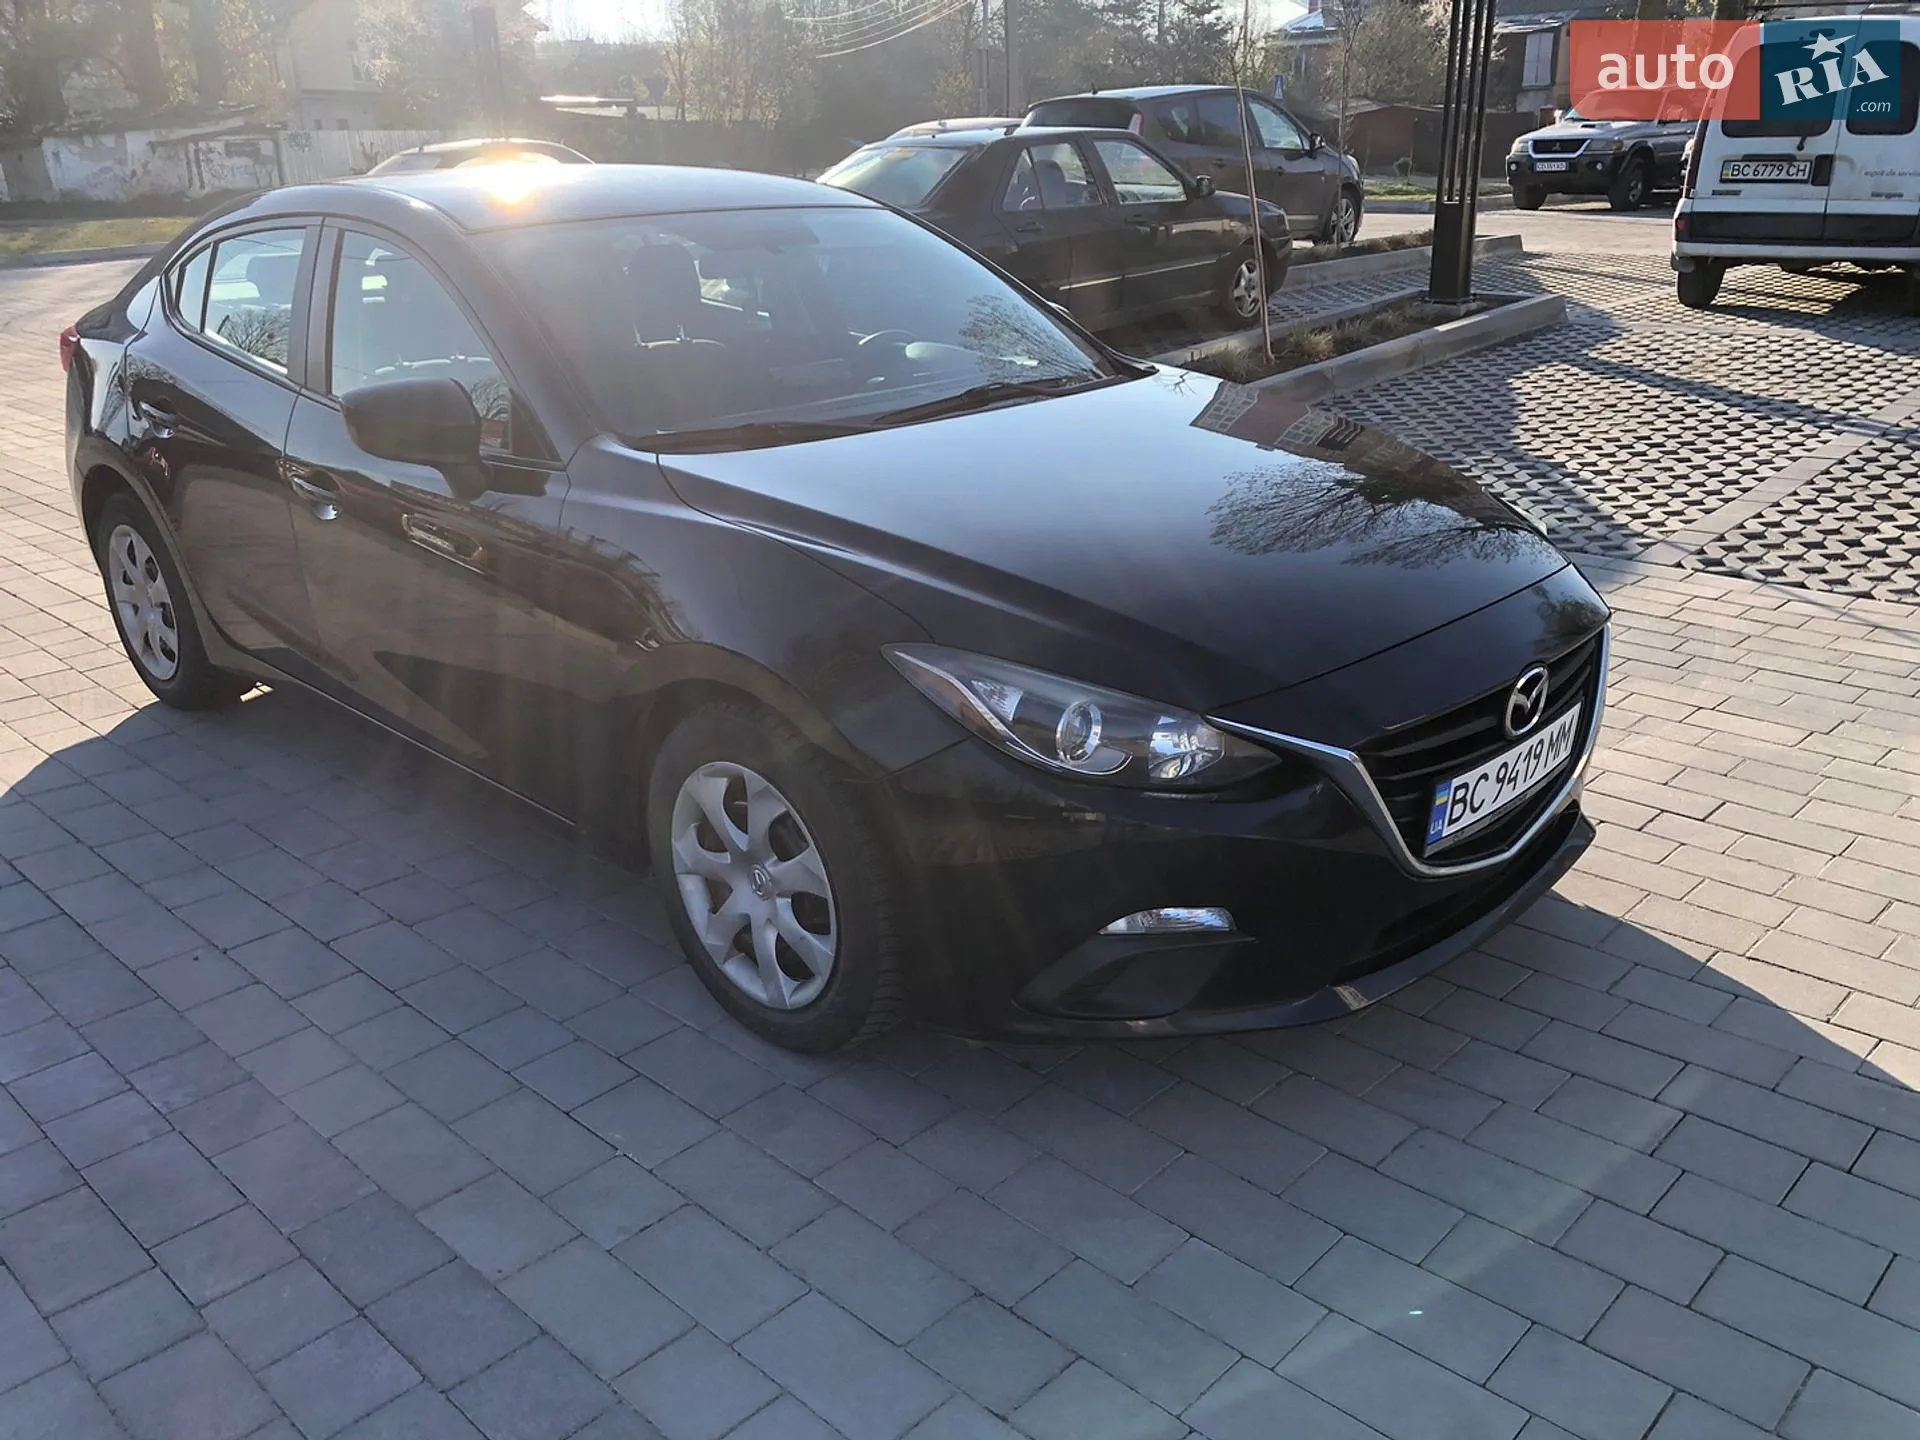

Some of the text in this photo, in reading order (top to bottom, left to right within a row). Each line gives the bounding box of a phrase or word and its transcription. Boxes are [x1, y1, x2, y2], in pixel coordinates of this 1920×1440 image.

[1731, 162, 1808, 177] BC 6779 CH
[1447, 773, 1489, 827] BC
[1493, 738, 1545, 804] 9419
[1545, 715, 1575, 769] MM
